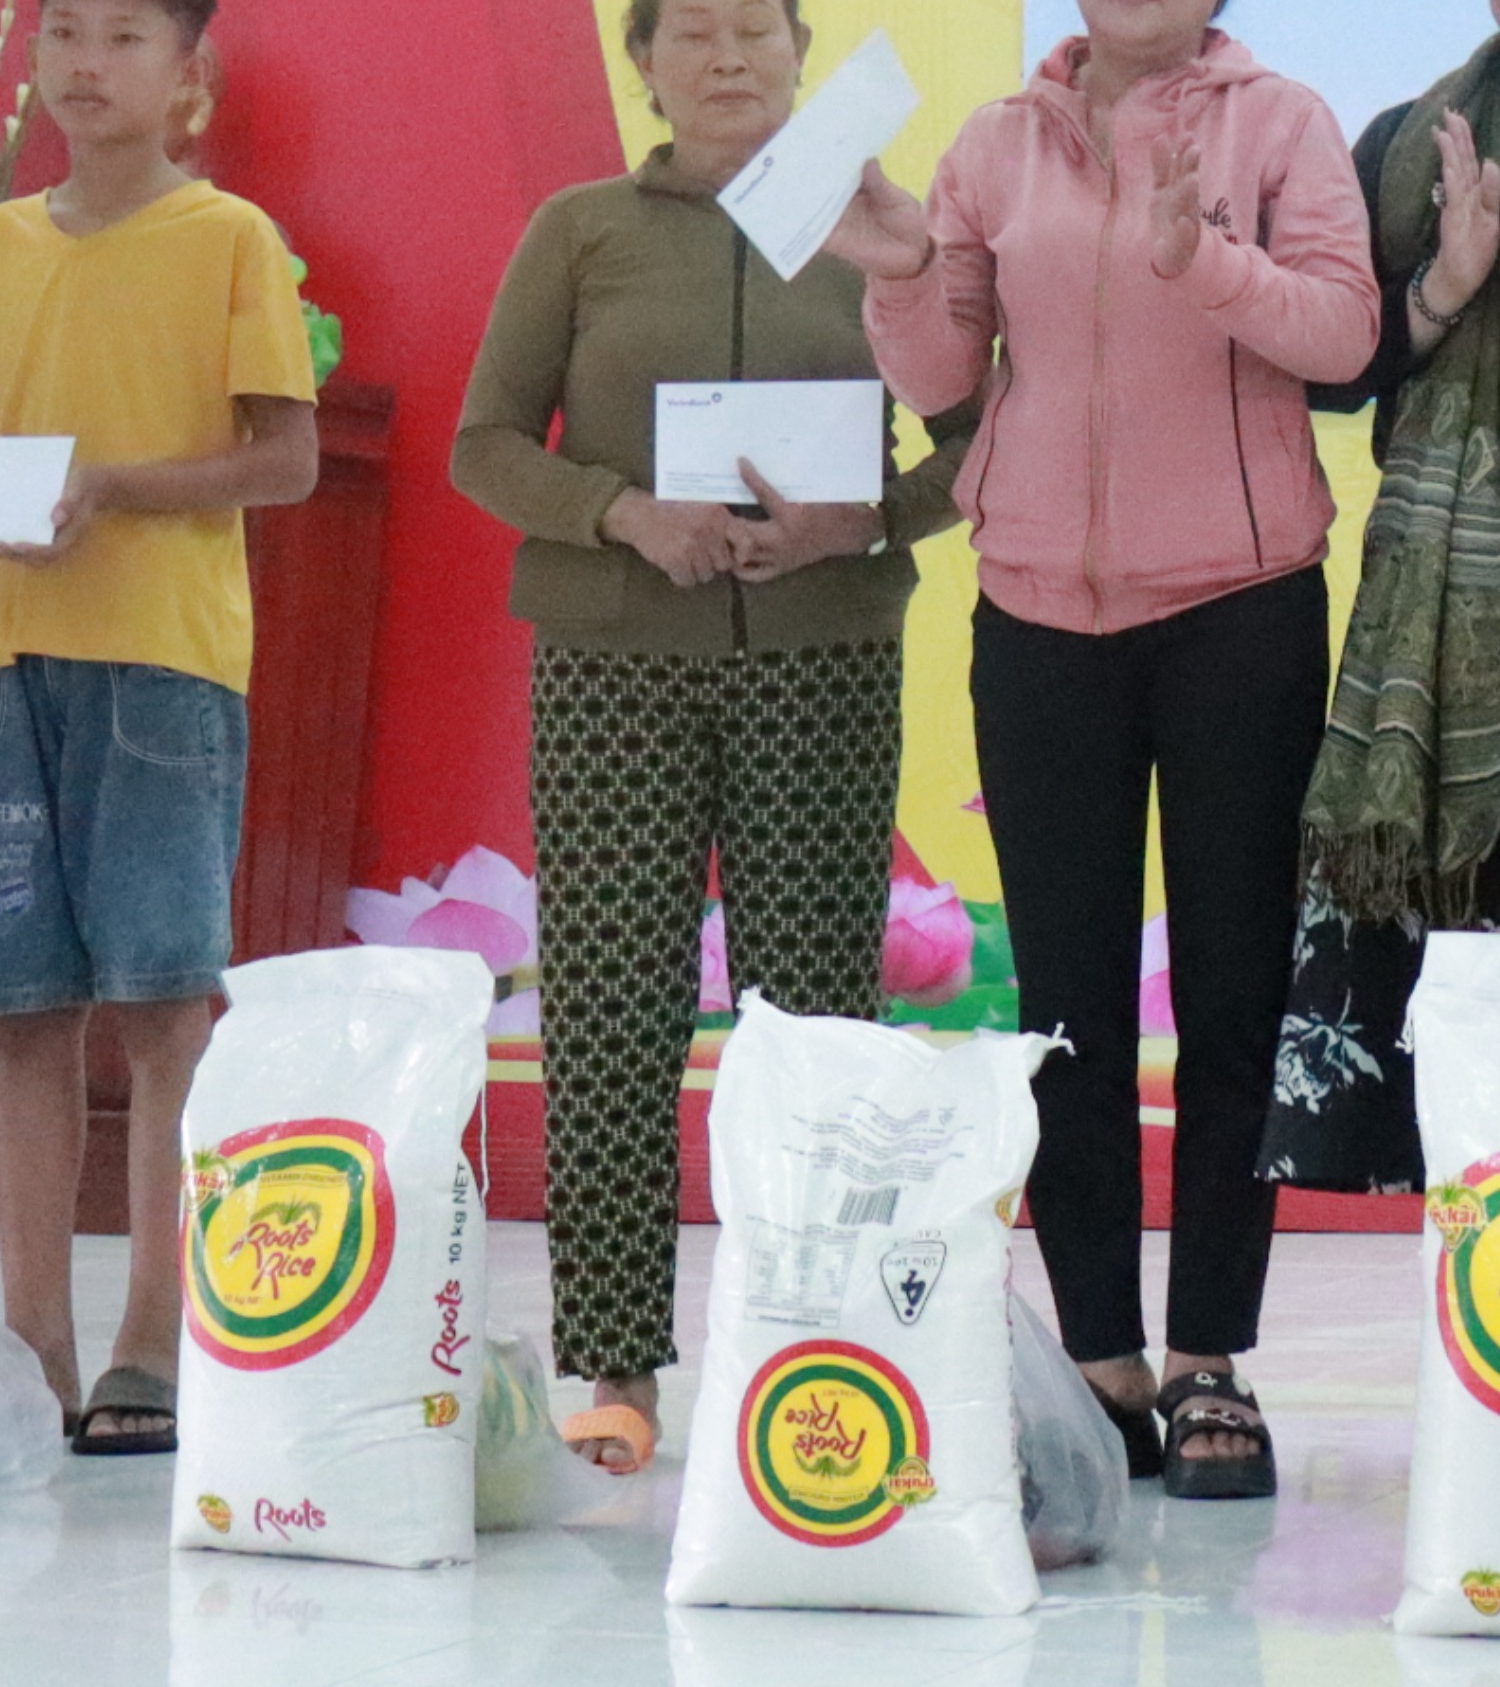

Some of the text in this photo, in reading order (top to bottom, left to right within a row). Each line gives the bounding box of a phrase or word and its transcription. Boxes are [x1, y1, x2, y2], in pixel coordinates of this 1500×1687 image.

[449, 1162, 470, 1265] 10 kg NET
[229, 1219, 313, 1270] Roots
[251, 1252, 316, 1300] Rice
[431, 1279, 471, 1377] Roots
[785, 1394, 839, 1433] Rice
[795, 1419, 867, 1461] Roots
[255, 1498, 327, 1543] Roots
